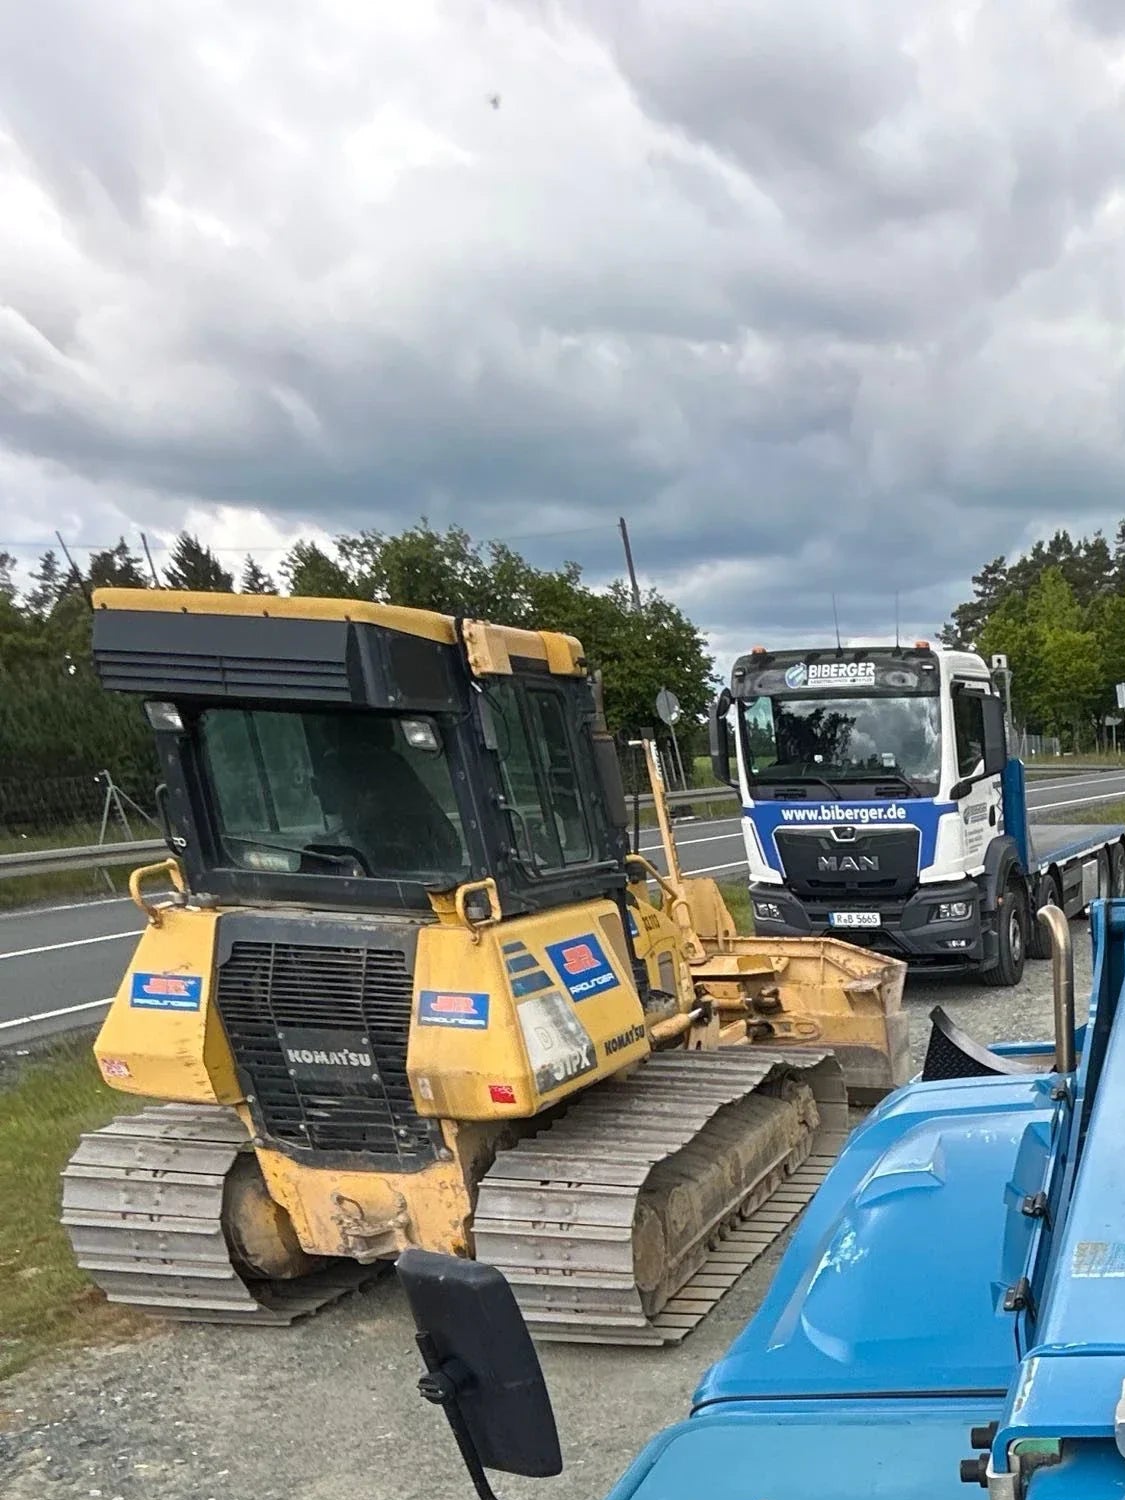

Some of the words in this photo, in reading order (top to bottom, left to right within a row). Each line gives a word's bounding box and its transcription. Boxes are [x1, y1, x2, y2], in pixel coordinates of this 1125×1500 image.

[809, 662, 875, 678] BIBERGER
[782, 805, 906, 823] www.biberger.de
[818, 856, 879, 871] MAN
[286, 1049, 371, 1067] KOMATSU
